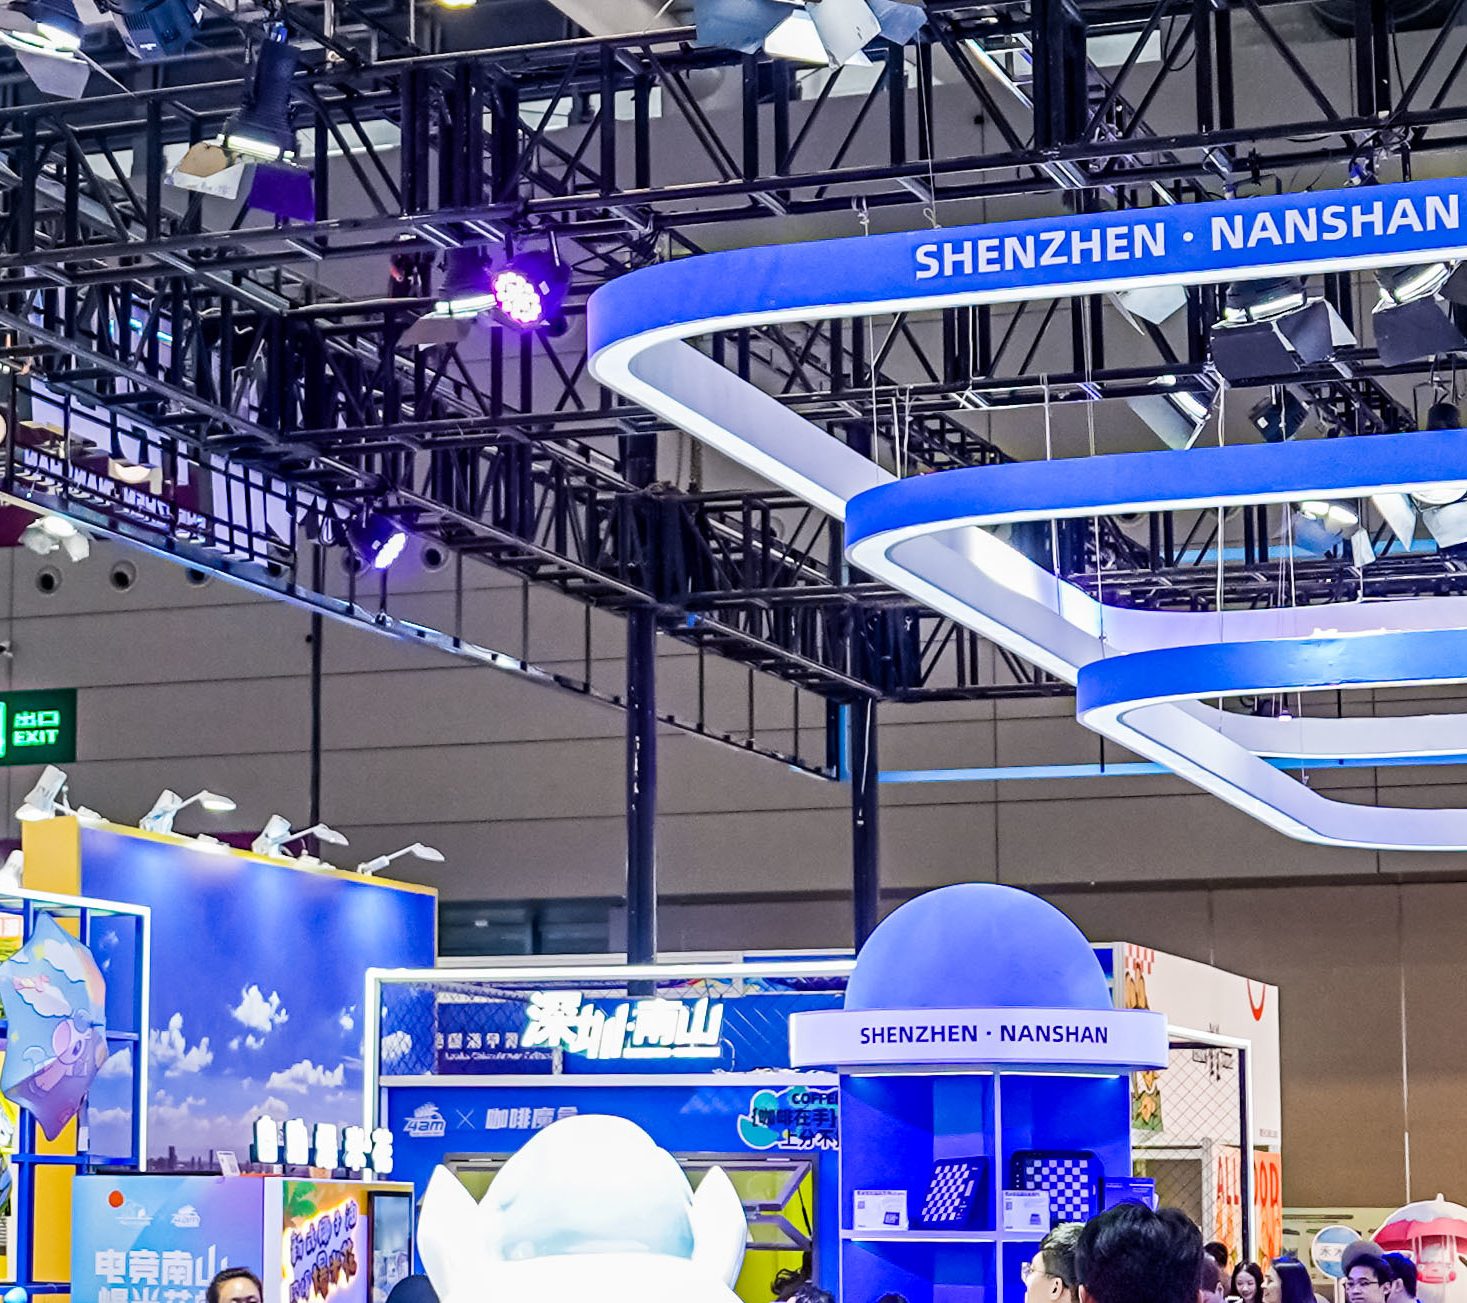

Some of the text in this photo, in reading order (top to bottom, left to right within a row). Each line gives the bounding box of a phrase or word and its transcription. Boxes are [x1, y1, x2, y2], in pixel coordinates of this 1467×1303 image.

[914, 221, 1166, 282] SHENZHEN
[1209, 193, 1461, 252] NANSHAN
[13, 709, 60, 728] 出口
[12, 729, 59, 747] EXIT
[859, 1025, 979, 1046] SHENZHEN
[999, 1022, 1109, 1045] NANSHAN
[94, 1242, 229, 1287] 电竞南山
